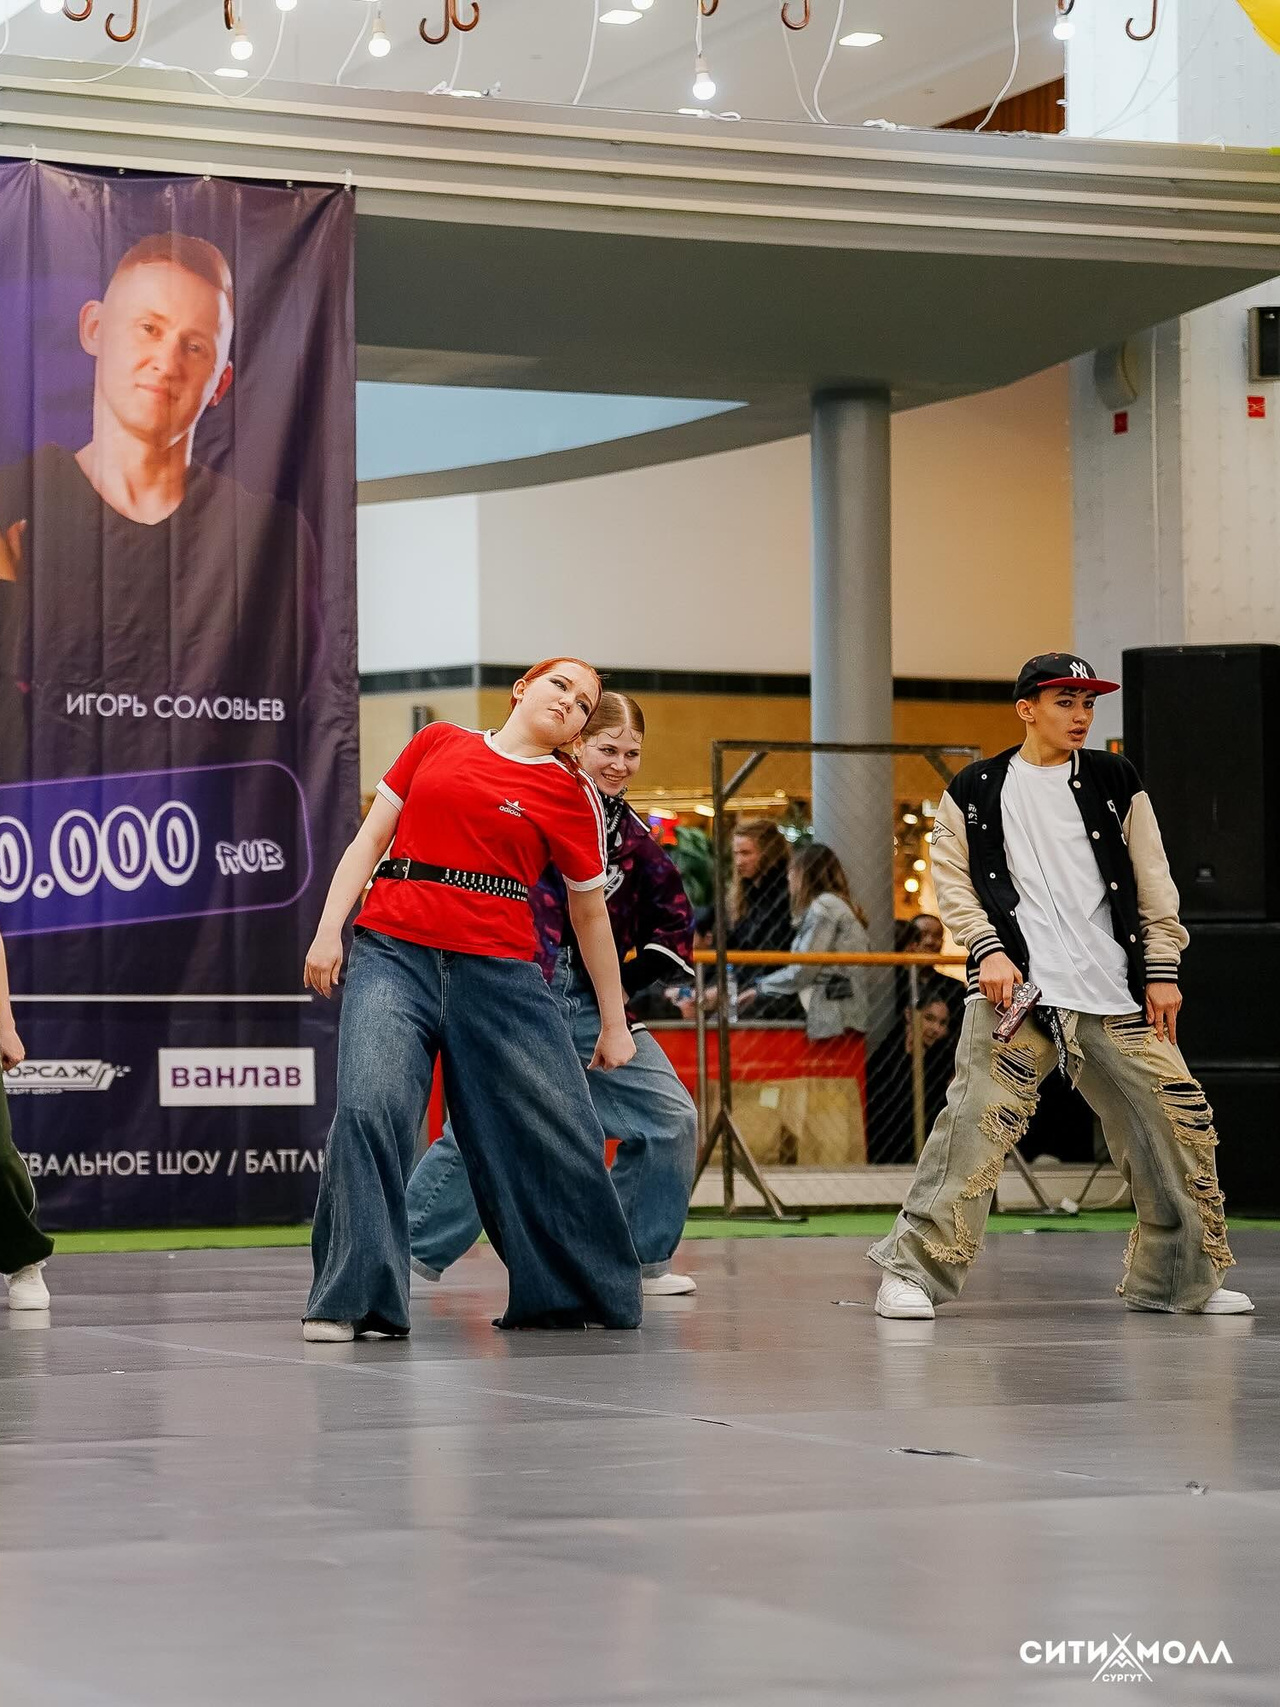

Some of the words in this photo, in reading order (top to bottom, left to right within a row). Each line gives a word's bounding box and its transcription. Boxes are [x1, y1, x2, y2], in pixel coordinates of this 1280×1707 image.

[66, 693, 147, 718] ИГОРЬ
[155, 694, 285, 721] СОЛОВЬЕВ
[215, 839, 285, 875] RUB
[171, 1065, 302, 1089] ванлав
[158, 1150, 220, 1175] ШОУ
